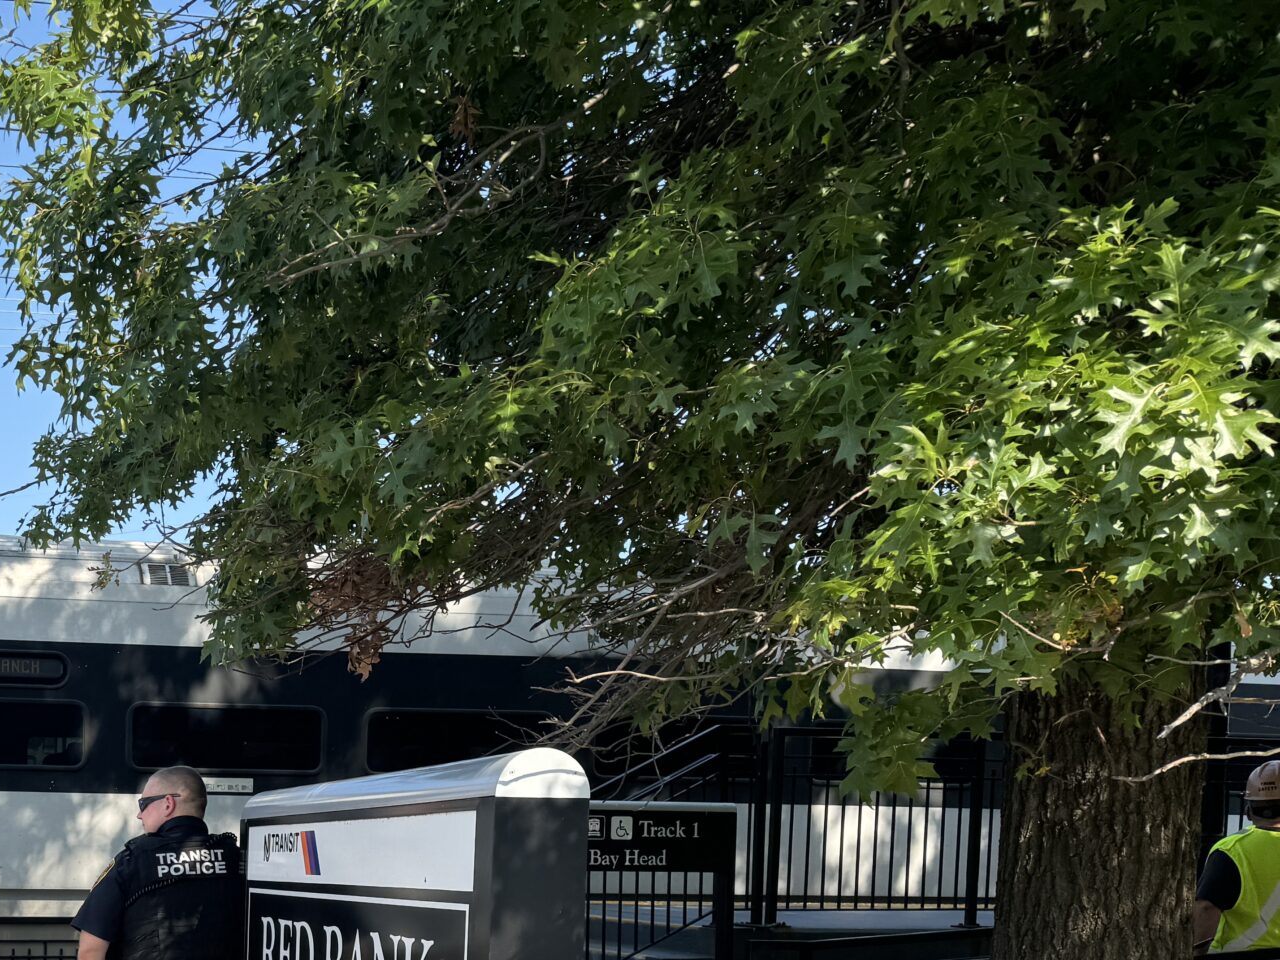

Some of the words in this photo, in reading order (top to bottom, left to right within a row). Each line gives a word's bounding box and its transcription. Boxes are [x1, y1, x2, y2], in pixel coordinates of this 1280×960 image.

[639, 820, 686, 838] Track
[692, 821, 701, 839] 1
[271, 832, 300, 852] TRANSIT
[155, 849, 224, 864] TRANSIT
[589, 849, 619, 869] Bay
[624, 849, 667, 866] Head
[157, 861, 227, 878] POLICE
